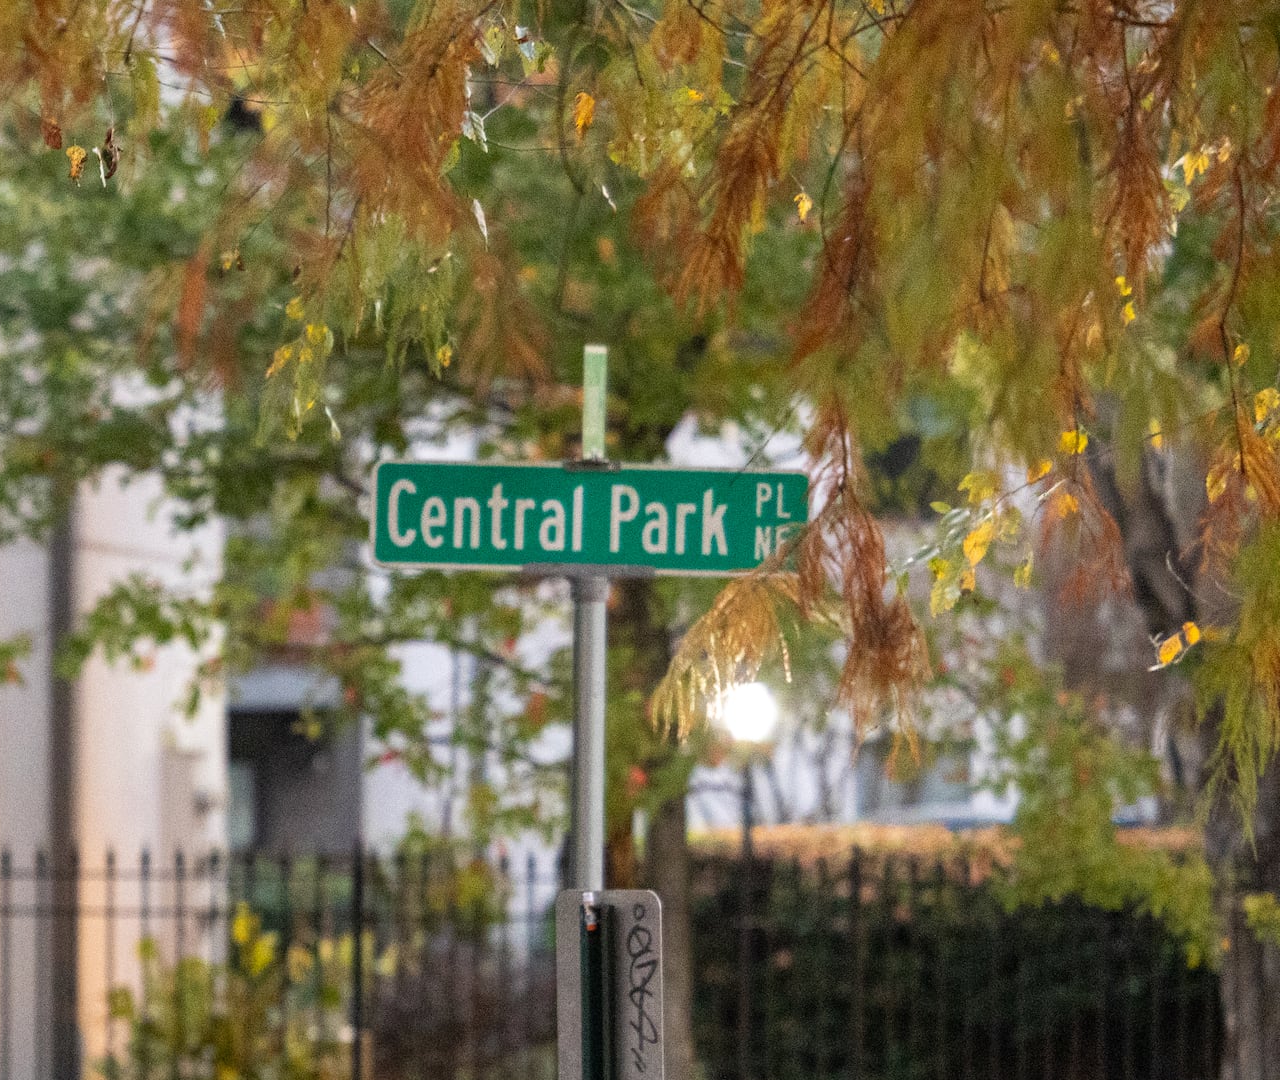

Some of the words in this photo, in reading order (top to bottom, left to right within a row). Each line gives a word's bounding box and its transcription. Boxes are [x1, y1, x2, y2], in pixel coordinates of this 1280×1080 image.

[388, 479, 583, 551] Central
[610, 485, 727, 555] Park
[756, 483, 790, 518] PL
